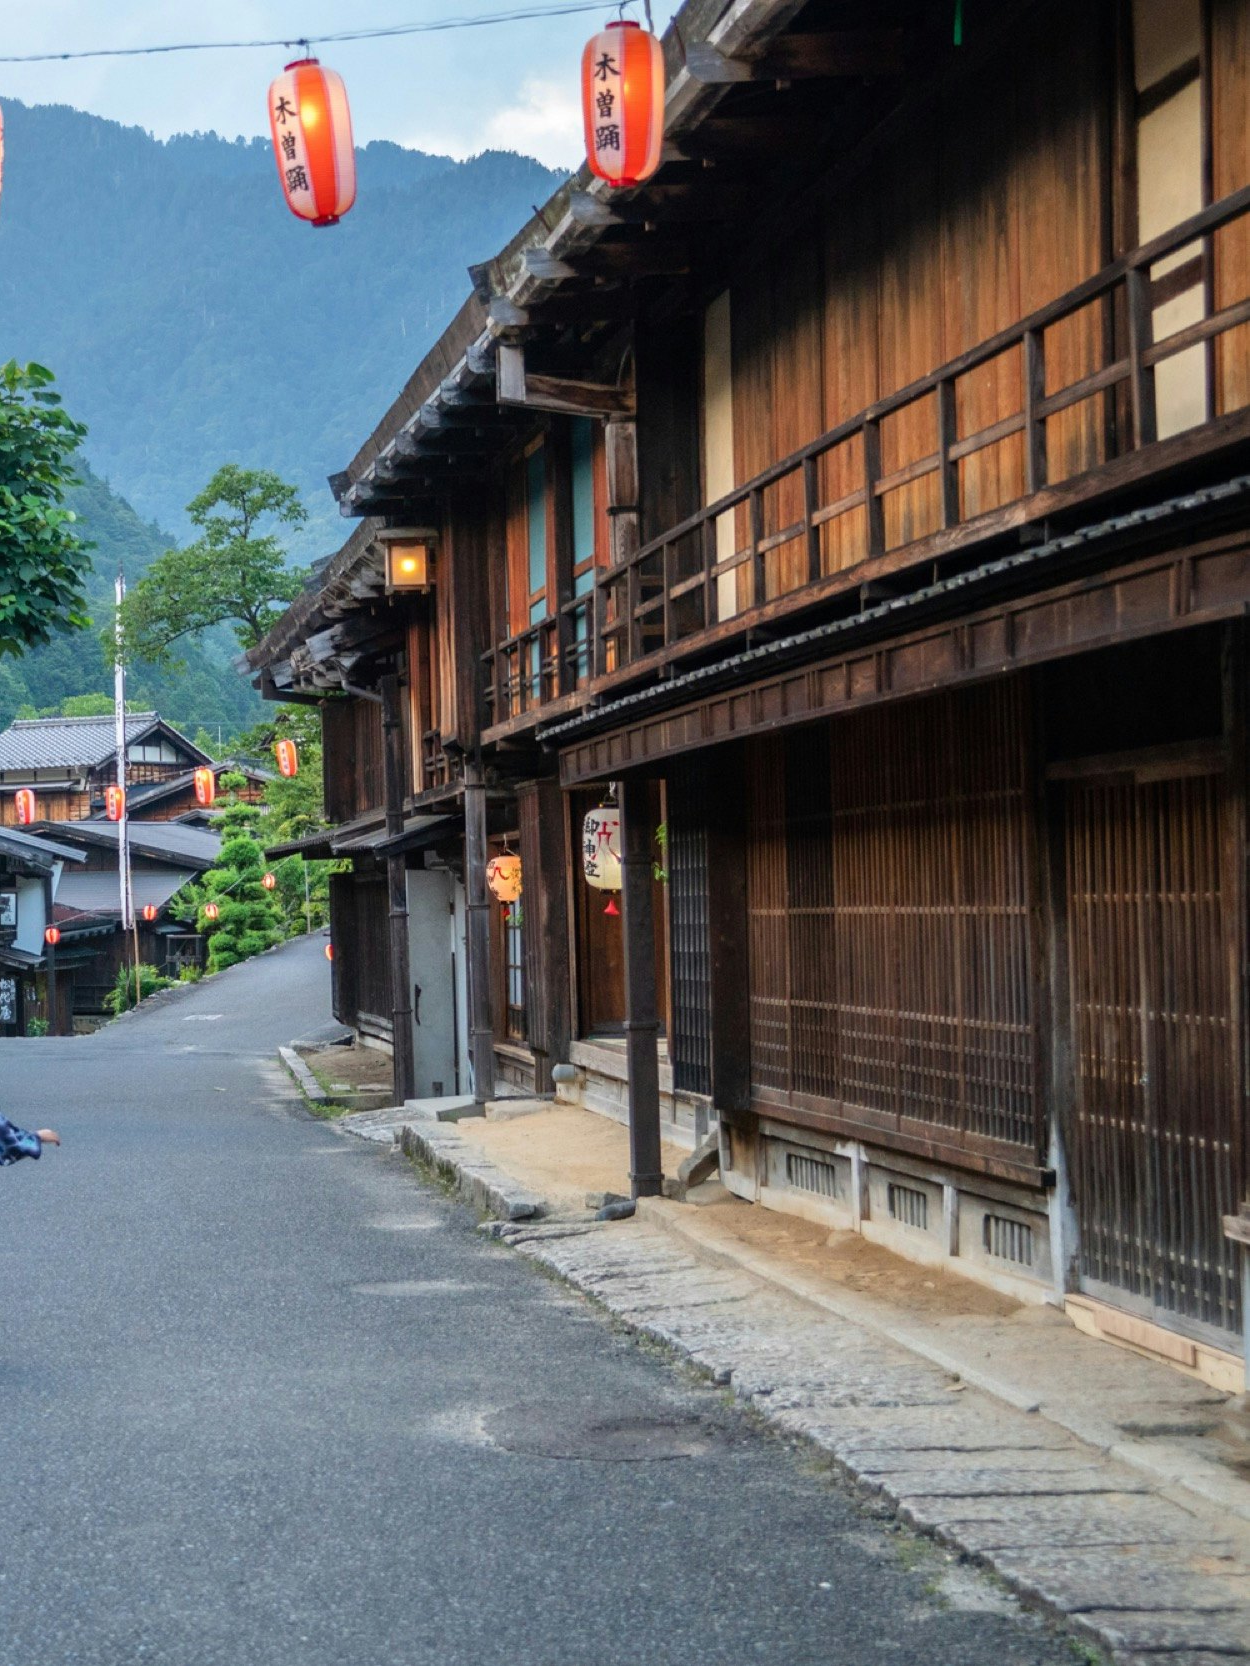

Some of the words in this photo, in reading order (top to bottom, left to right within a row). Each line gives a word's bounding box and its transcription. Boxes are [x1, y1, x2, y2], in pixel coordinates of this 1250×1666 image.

[274, 96, 310, 194] 木曽踊
[595, 52, 621, 153] 木曽踊
